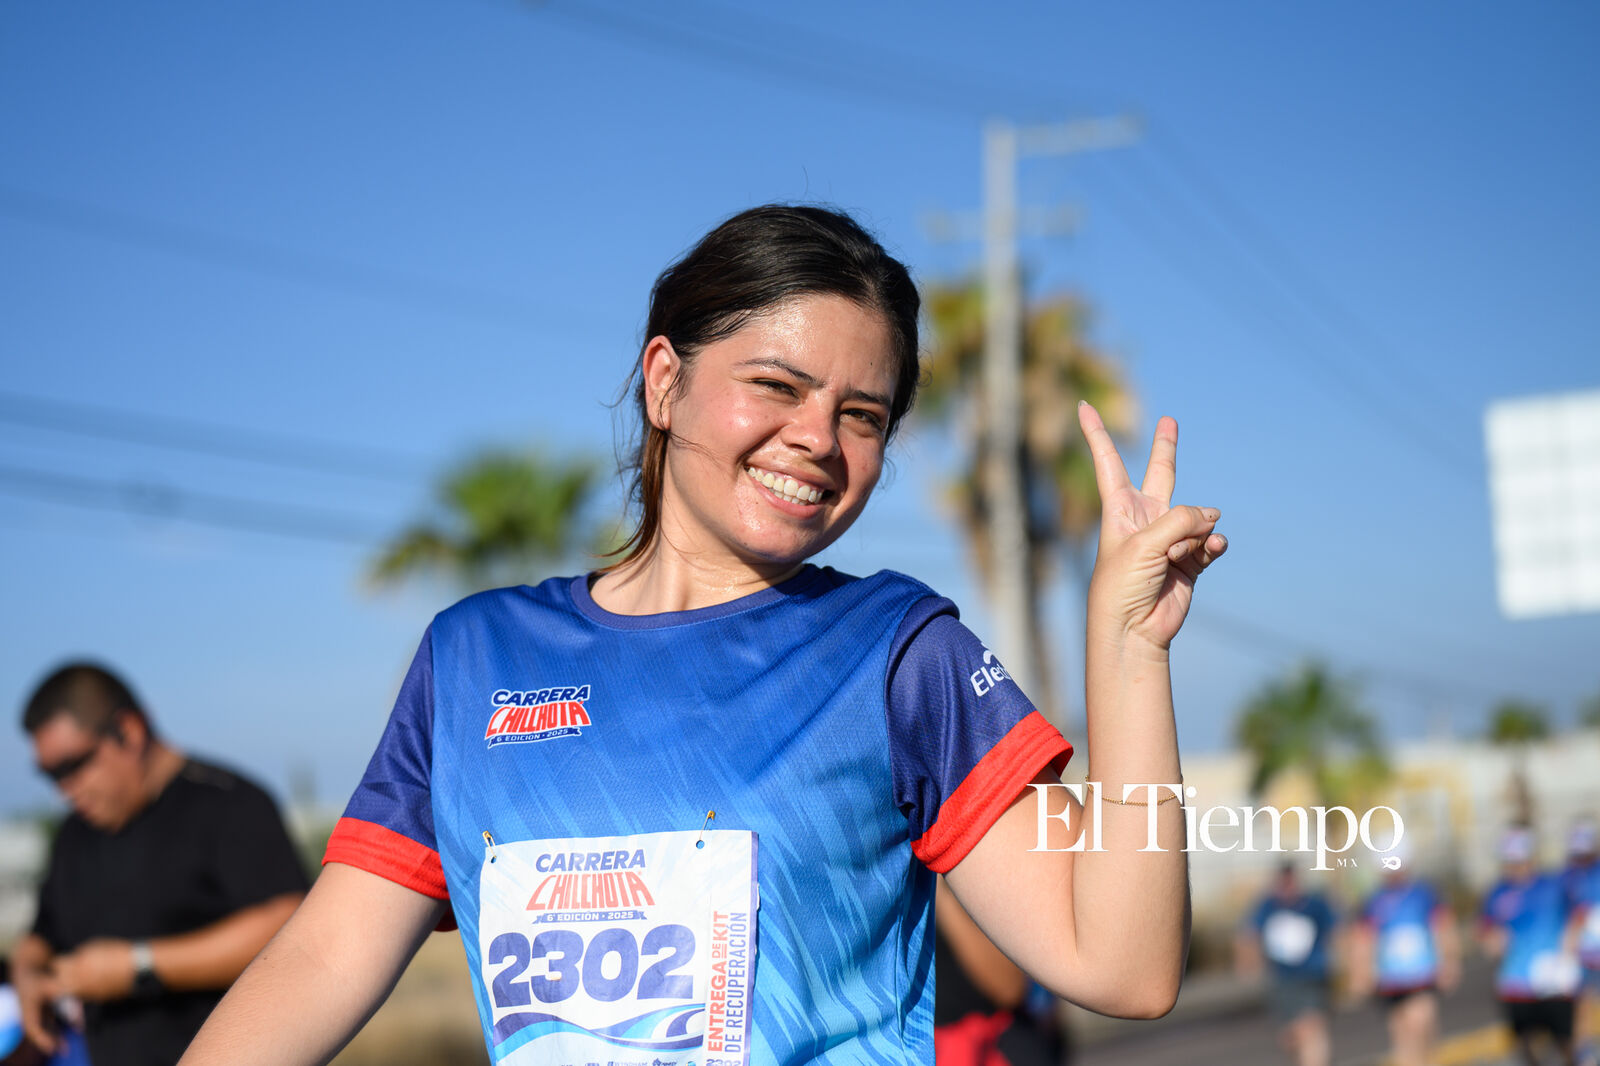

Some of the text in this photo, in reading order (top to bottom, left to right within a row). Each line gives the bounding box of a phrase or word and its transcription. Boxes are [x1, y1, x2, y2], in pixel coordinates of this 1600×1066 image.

[492, 685, 590, 706] CARRERA
[970, 663, 1011, 697] Ele
[485, 701, 591, 739] CHILCHOTA
[547, 728, 569, 738] 2025
[535, 849, 646, 872] CARRERA
[526, 871, 656, 911] CHILCHOTA
[607, 911, 634, 920] 2025
[488, 924, 696, 1008] 2302
[708, 911, 729, 1052] ENTREGA DE KIT
[724, 912, 747, 1053] DE RECUPERACIÓN
